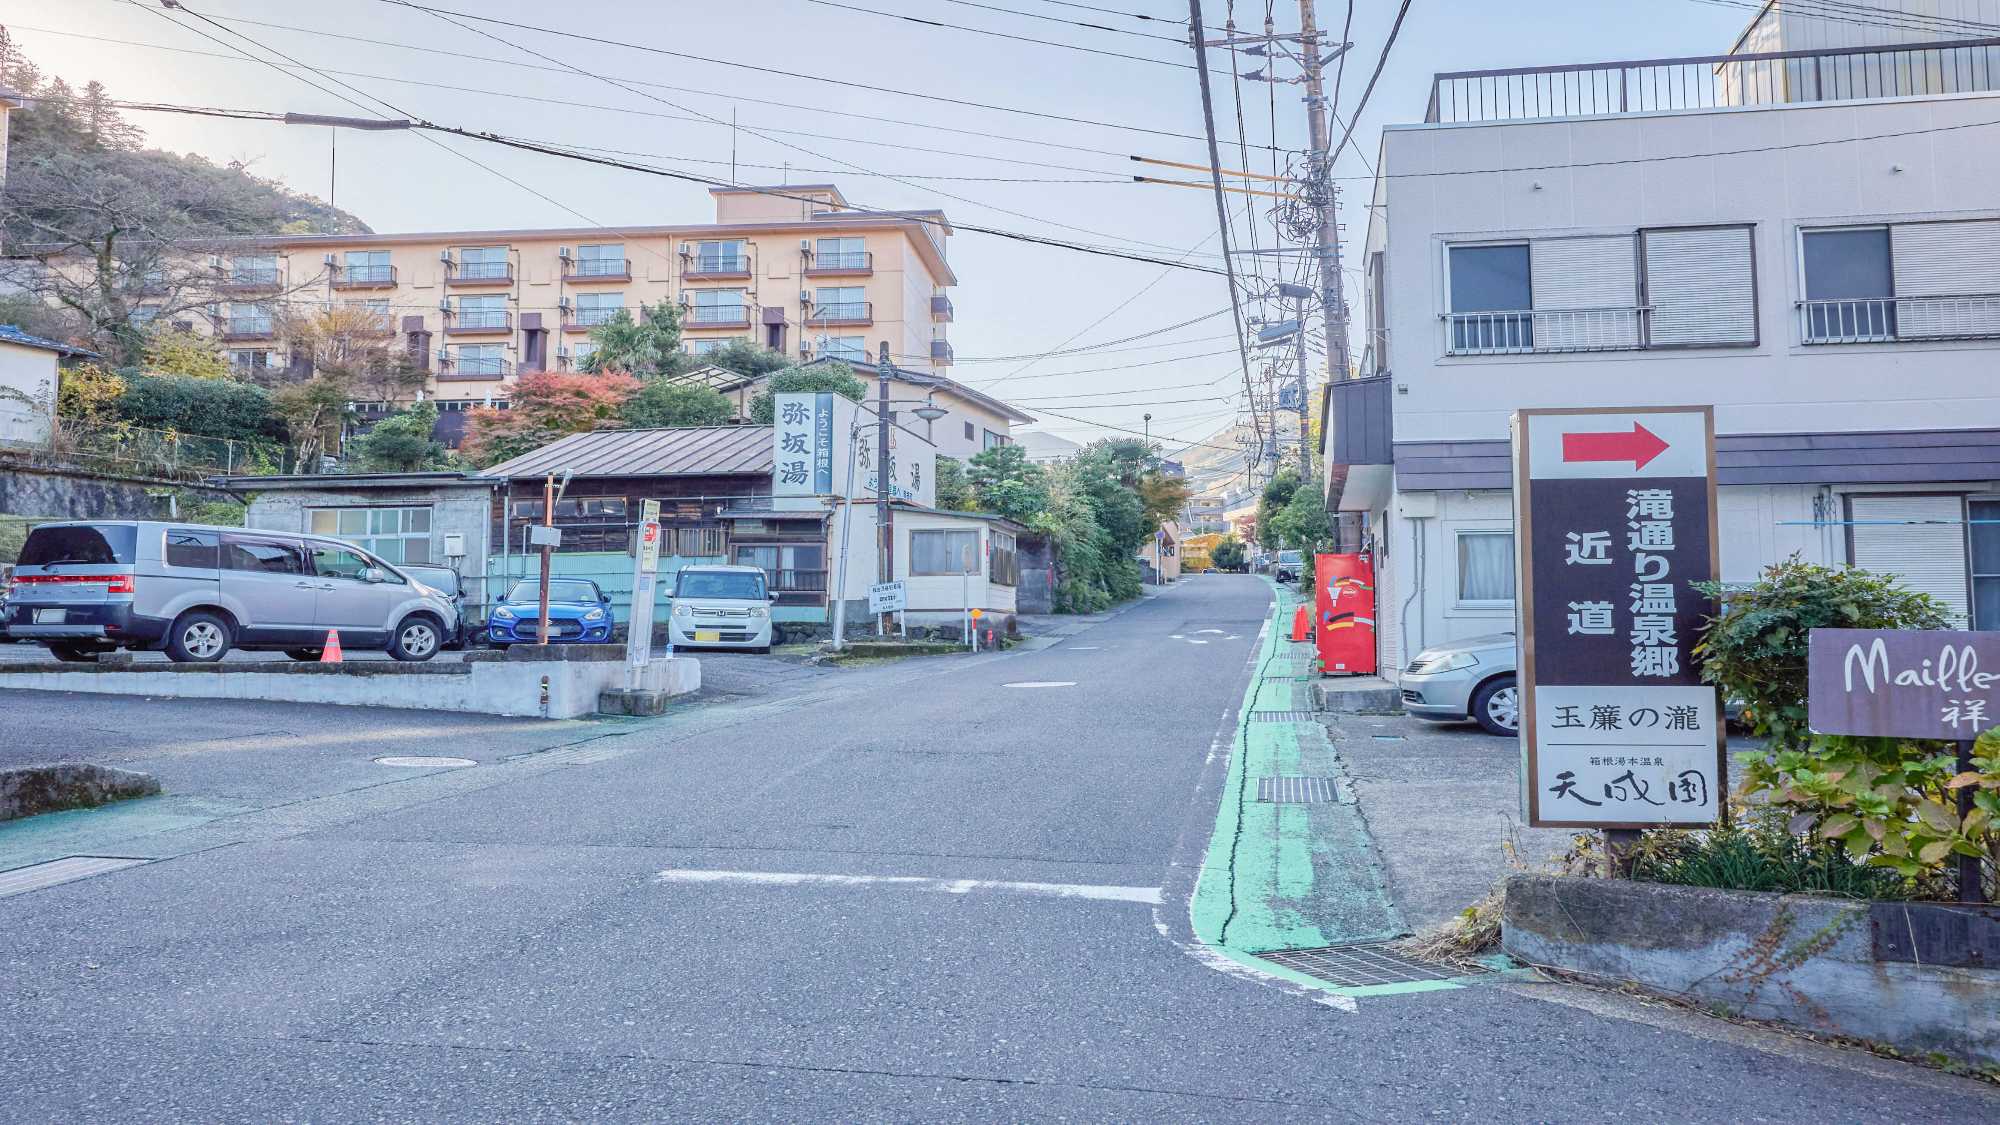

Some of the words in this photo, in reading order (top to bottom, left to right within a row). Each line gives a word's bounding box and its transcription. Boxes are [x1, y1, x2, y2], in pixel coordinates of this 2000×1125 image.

[781, 402, 811, 485] 弥坂湯
[817, 409, 830, 474] ようこそ箱根へ
[1565, 531, 1615, 635] 近道
[1625, 489, 1679, 677] 滝通り温泉郷
[1845, 638, 2000, 694] Maille
[1551, 704, 1701, 731] 玉簾の瀧
[1941, 700, 1990, 733] 祥
[1549, 770, 1708, 806] 天成園
[1589, 756, 1665, 766] 箱根湯本温泉
